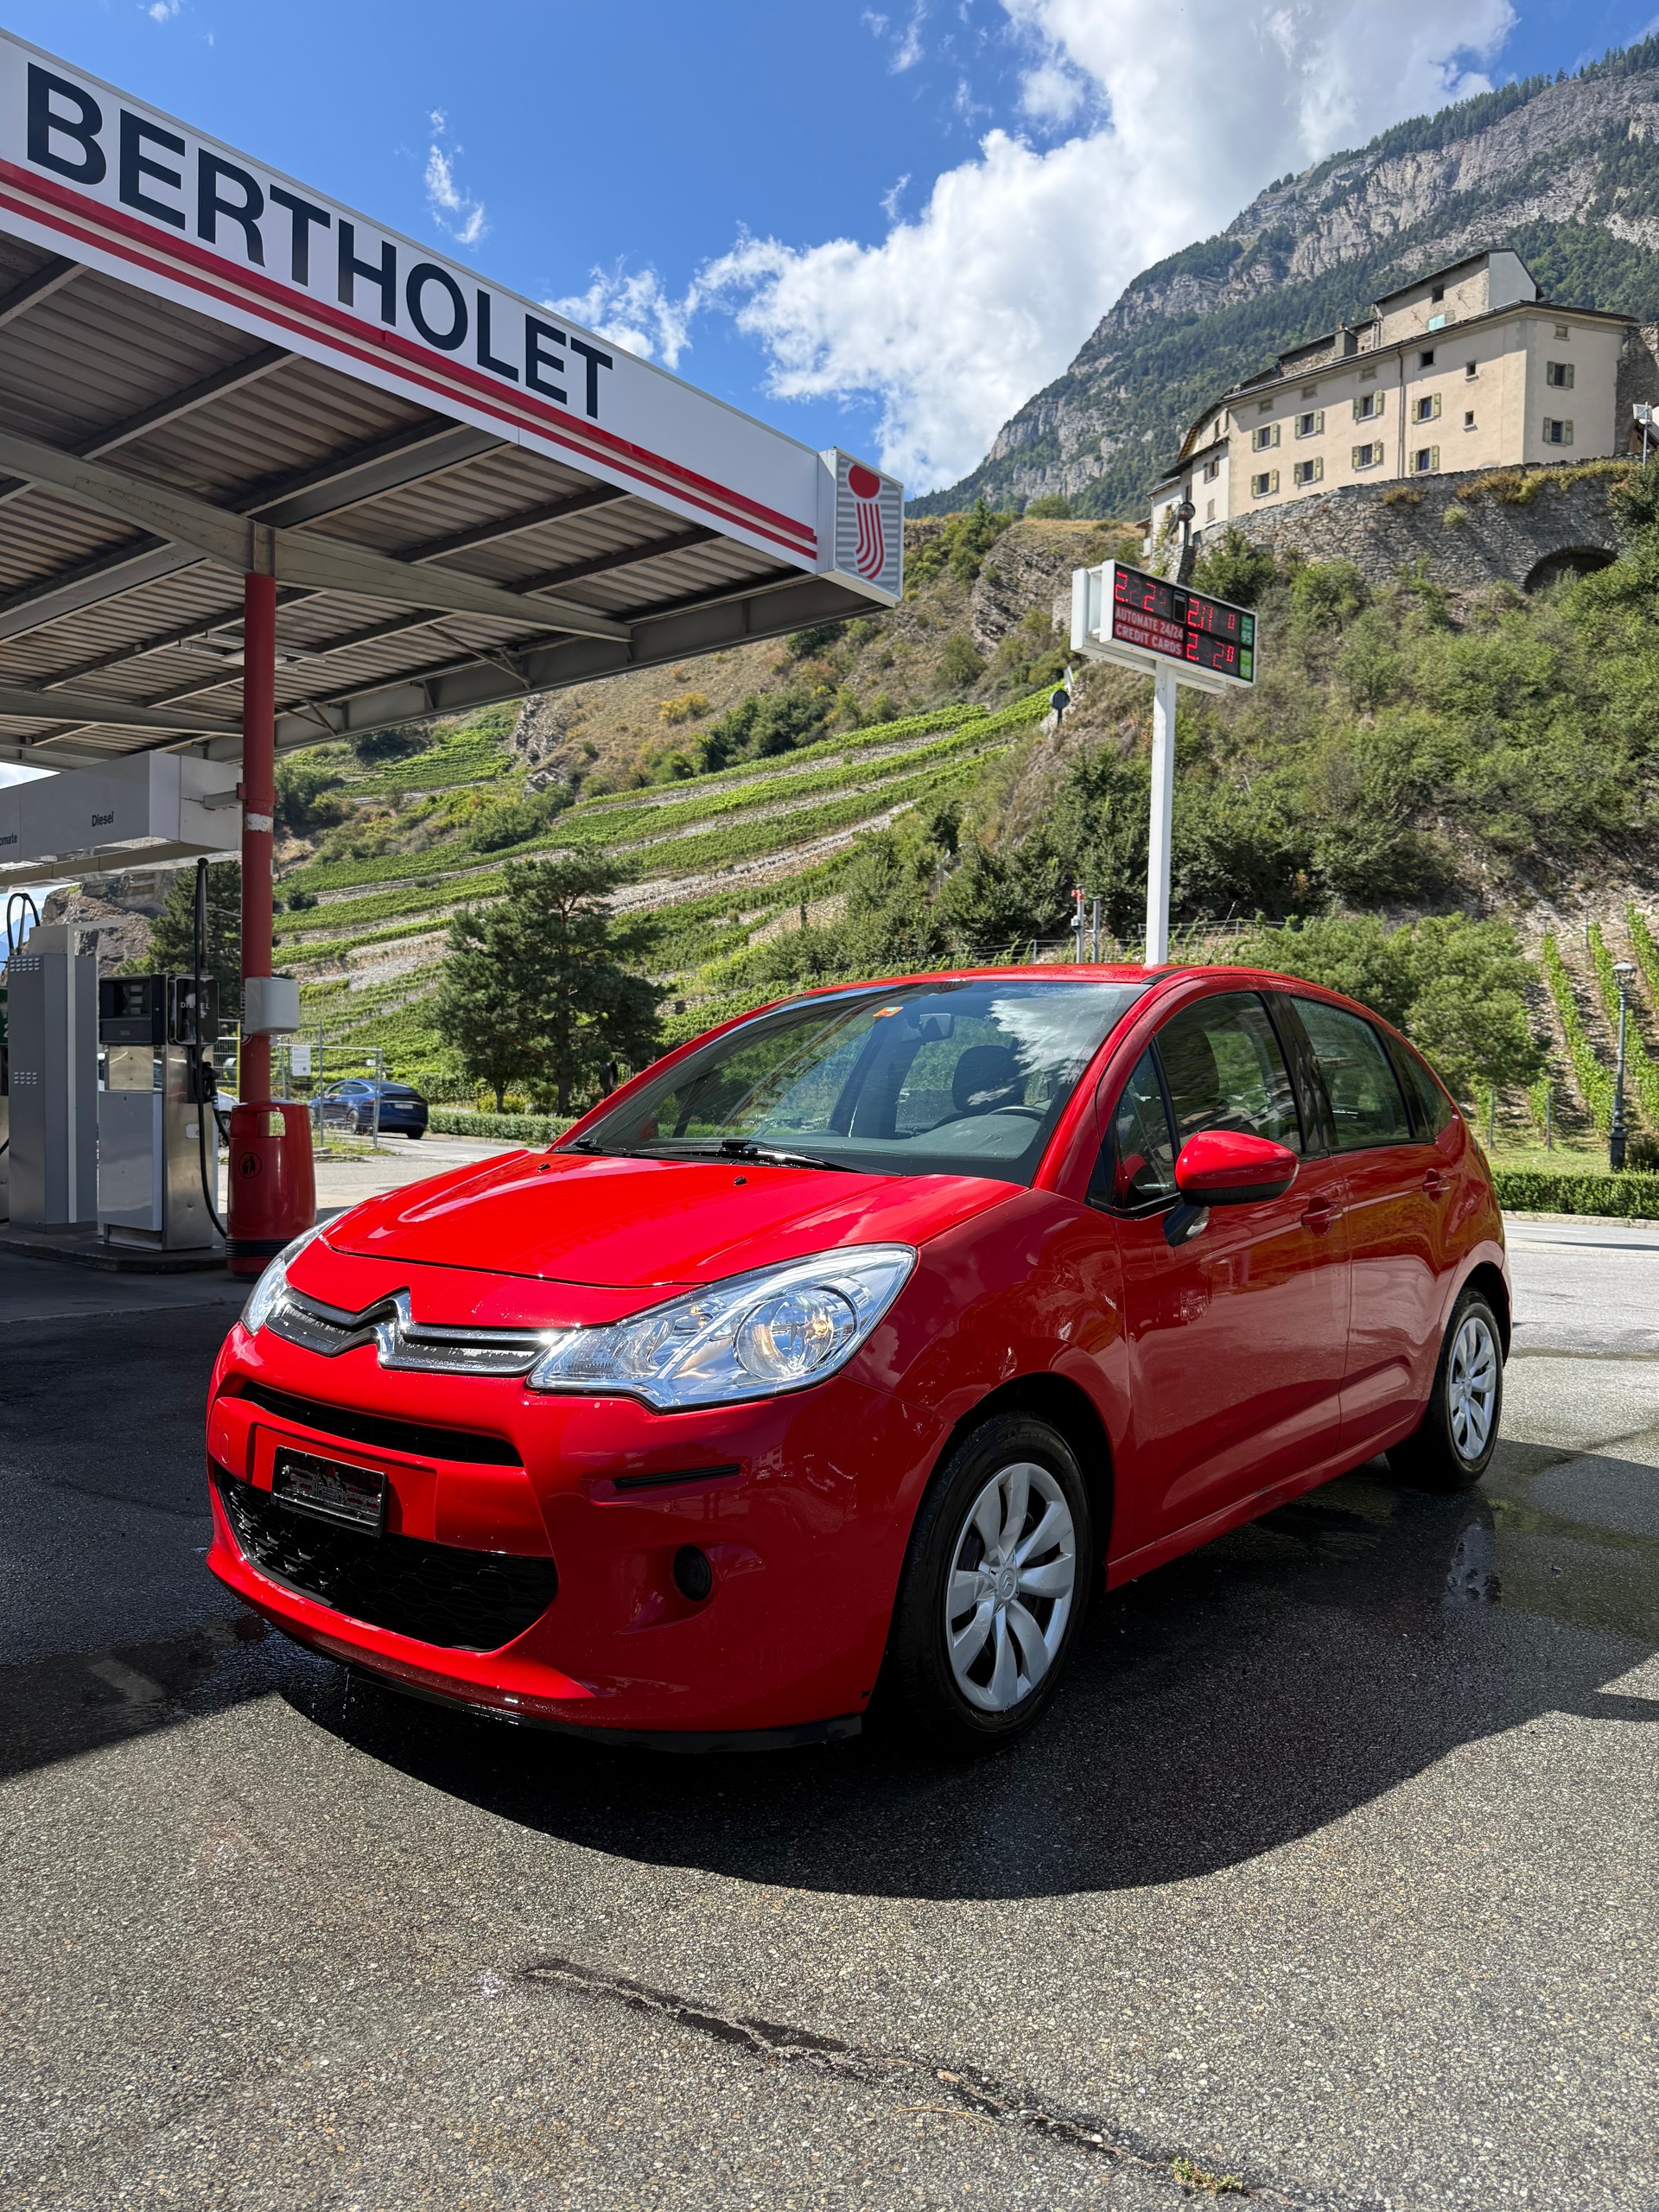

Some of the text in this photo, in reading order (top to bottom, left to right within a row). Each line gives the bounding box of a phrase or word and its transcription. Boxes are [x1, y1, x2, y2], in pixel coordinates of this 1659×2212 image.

[27, 61, 613, 420] BERTHOLET
[1115, 607, 1184, 641] AUTOMATE 24/24
[1116, 624, 1181, 655] CREDIT CARDS
[92, 810, 114, 827] Diesel
[180, 1001, 211, 1010] DIEEL
